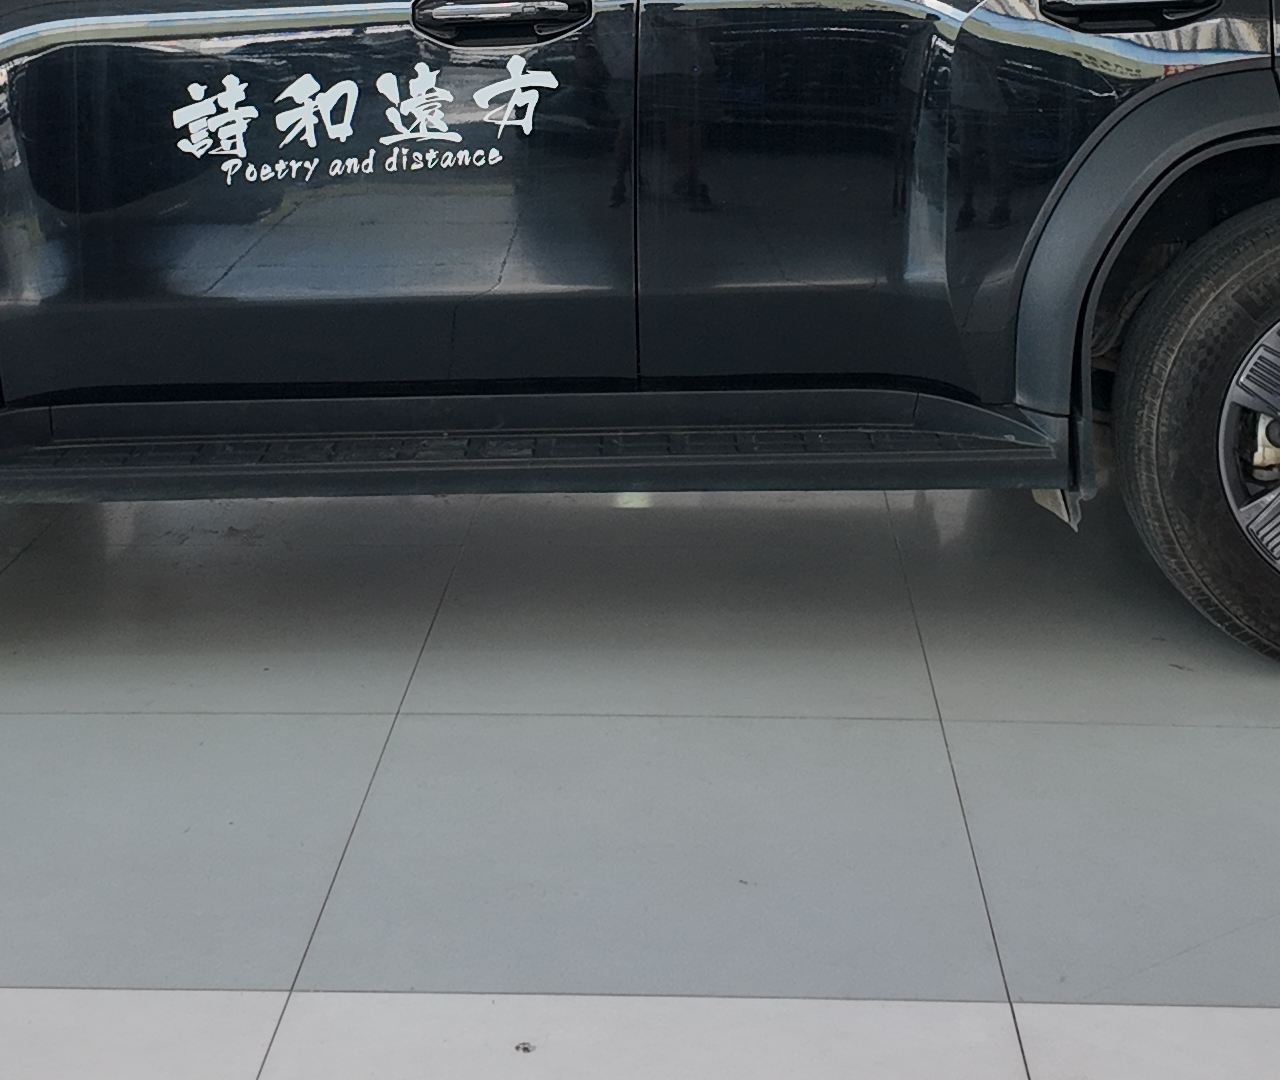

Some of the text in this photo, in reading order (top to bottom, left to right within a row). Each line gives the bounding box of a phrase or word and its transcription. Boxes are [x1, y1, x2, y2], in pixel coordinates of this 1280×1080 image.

[220, 146, 505, 185] Poetry and distance
